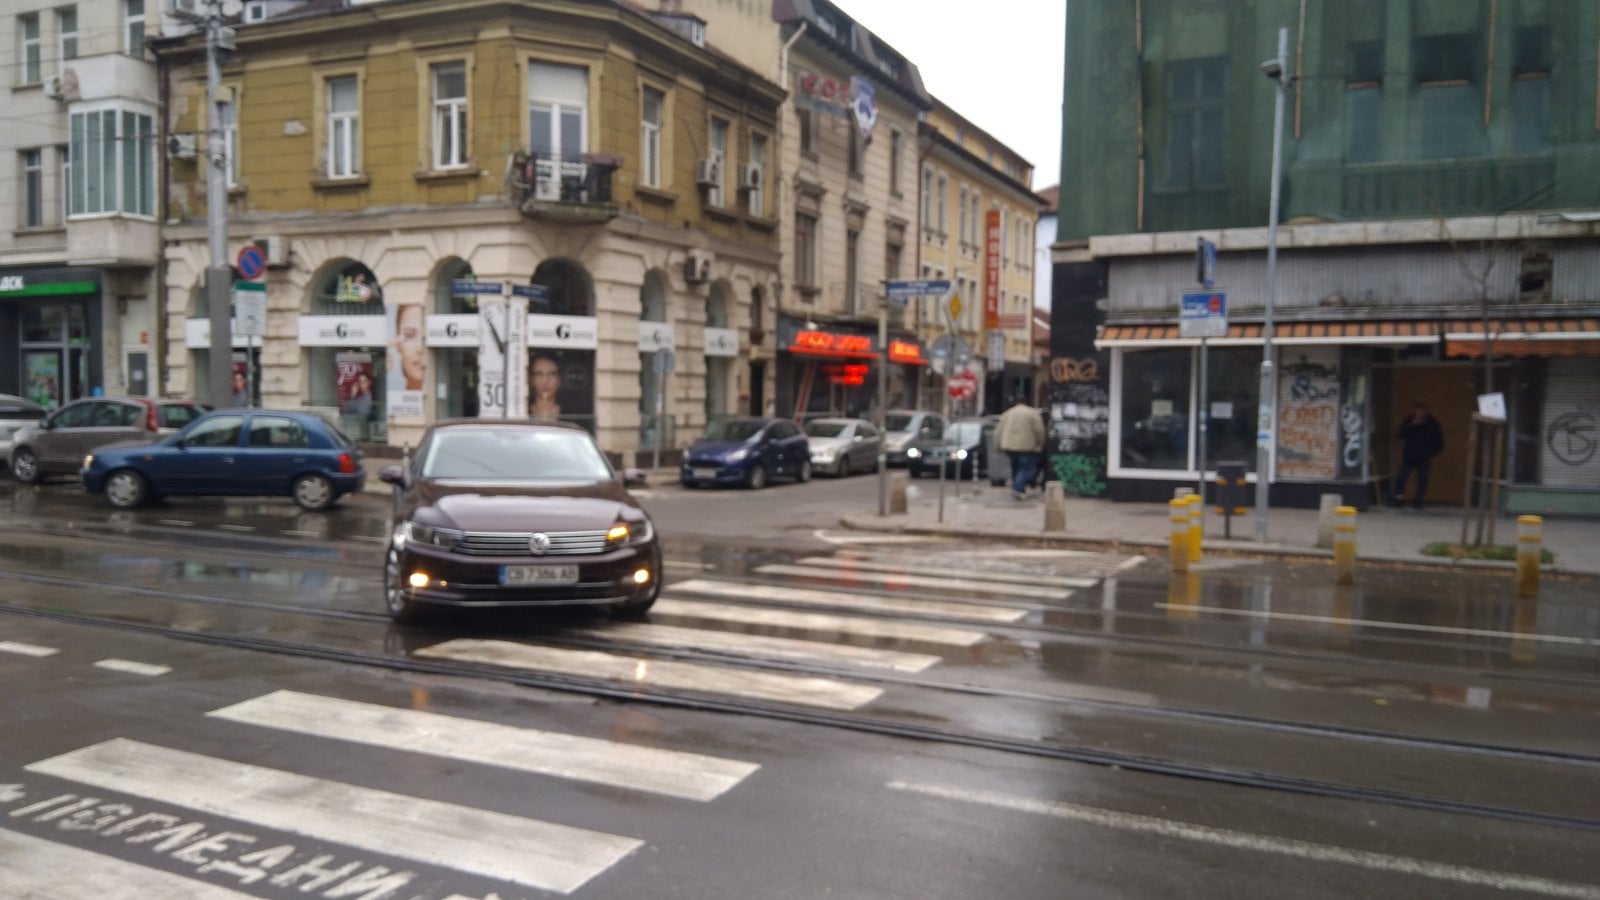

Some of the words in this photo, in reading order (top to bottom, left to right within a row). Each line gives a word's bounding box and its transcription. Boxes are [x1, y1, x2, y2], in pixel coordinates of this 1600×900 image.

[987, 226, 1001, 313] HOSTEL
[556, 323, 571, 338] G
[484, 383, 505, 408] 30
[9, 793, 415, 900] ПОГЛЕДНИ
